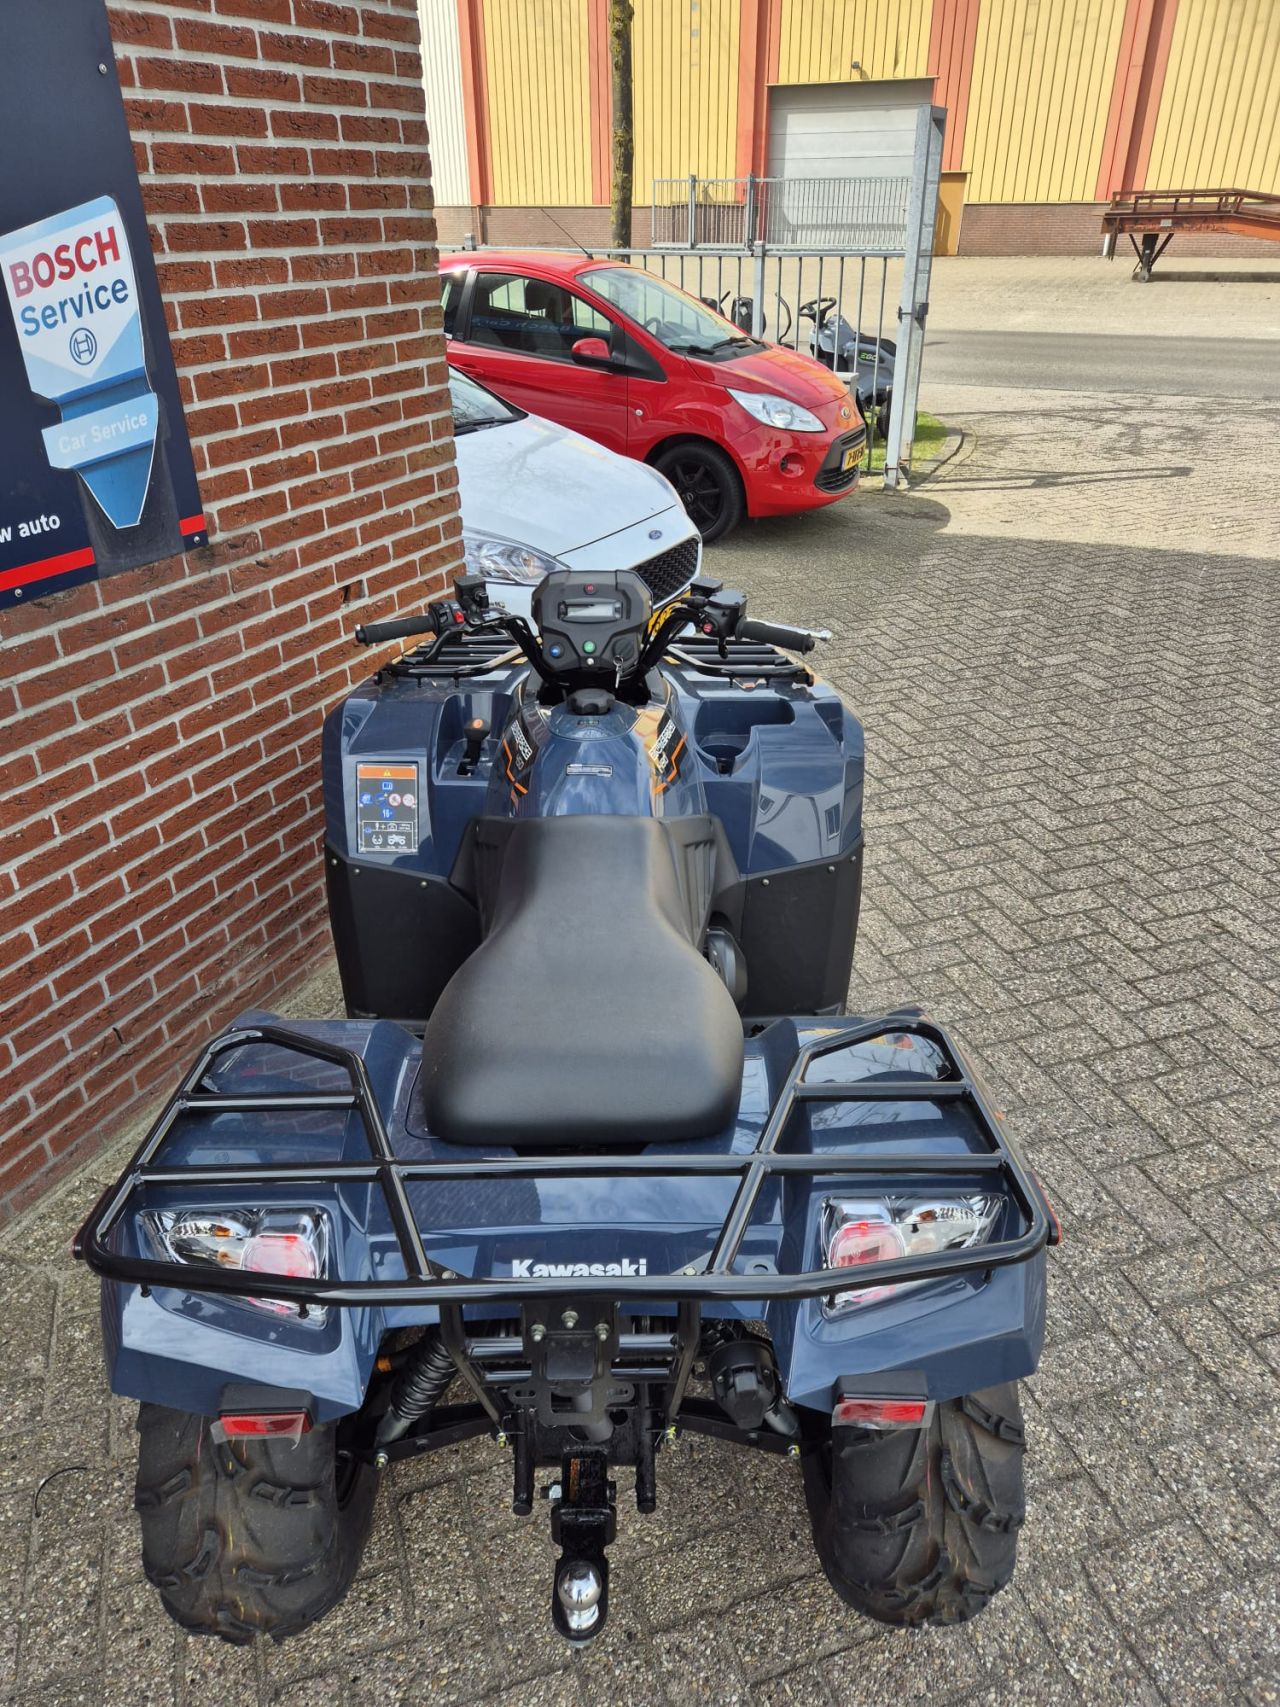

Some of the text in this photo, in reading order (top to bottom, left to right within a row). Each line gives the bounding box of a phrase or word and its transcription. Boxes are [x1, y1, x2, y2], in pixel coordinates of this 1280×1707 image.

[9, 226, 120, 298] BOSCH
[20, 278, 129, 337] Service
[58, 412, 148, 454] Car Service
[18, 514, 61, 538] auto
[512, 1258, 647, 1277] Kawasaki
